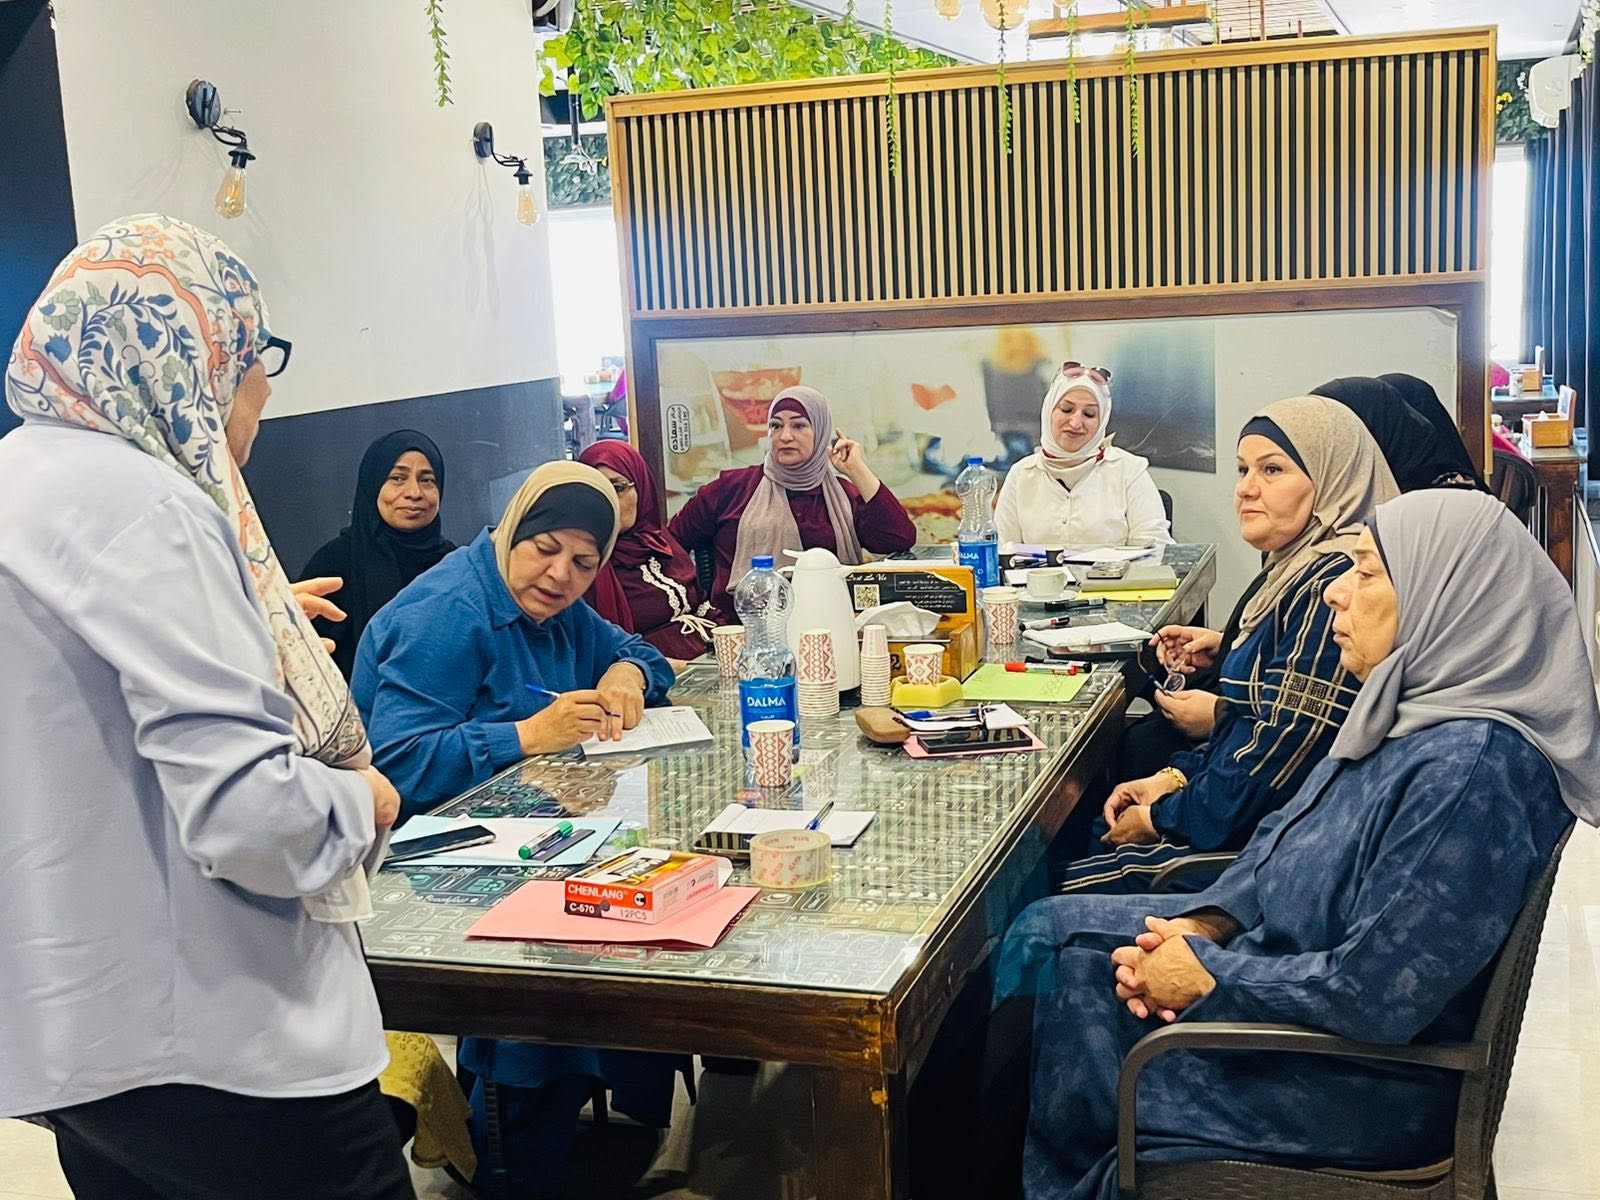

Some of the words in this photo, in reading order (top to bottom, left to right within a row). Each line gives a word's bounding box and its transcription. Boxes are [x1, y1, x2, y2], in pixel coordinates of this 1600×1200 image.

[747, 696, 787, 707] DALMA
[567, 884, 624, 901] CHENLANG
[620, 909, 648, 920] 12PCS
